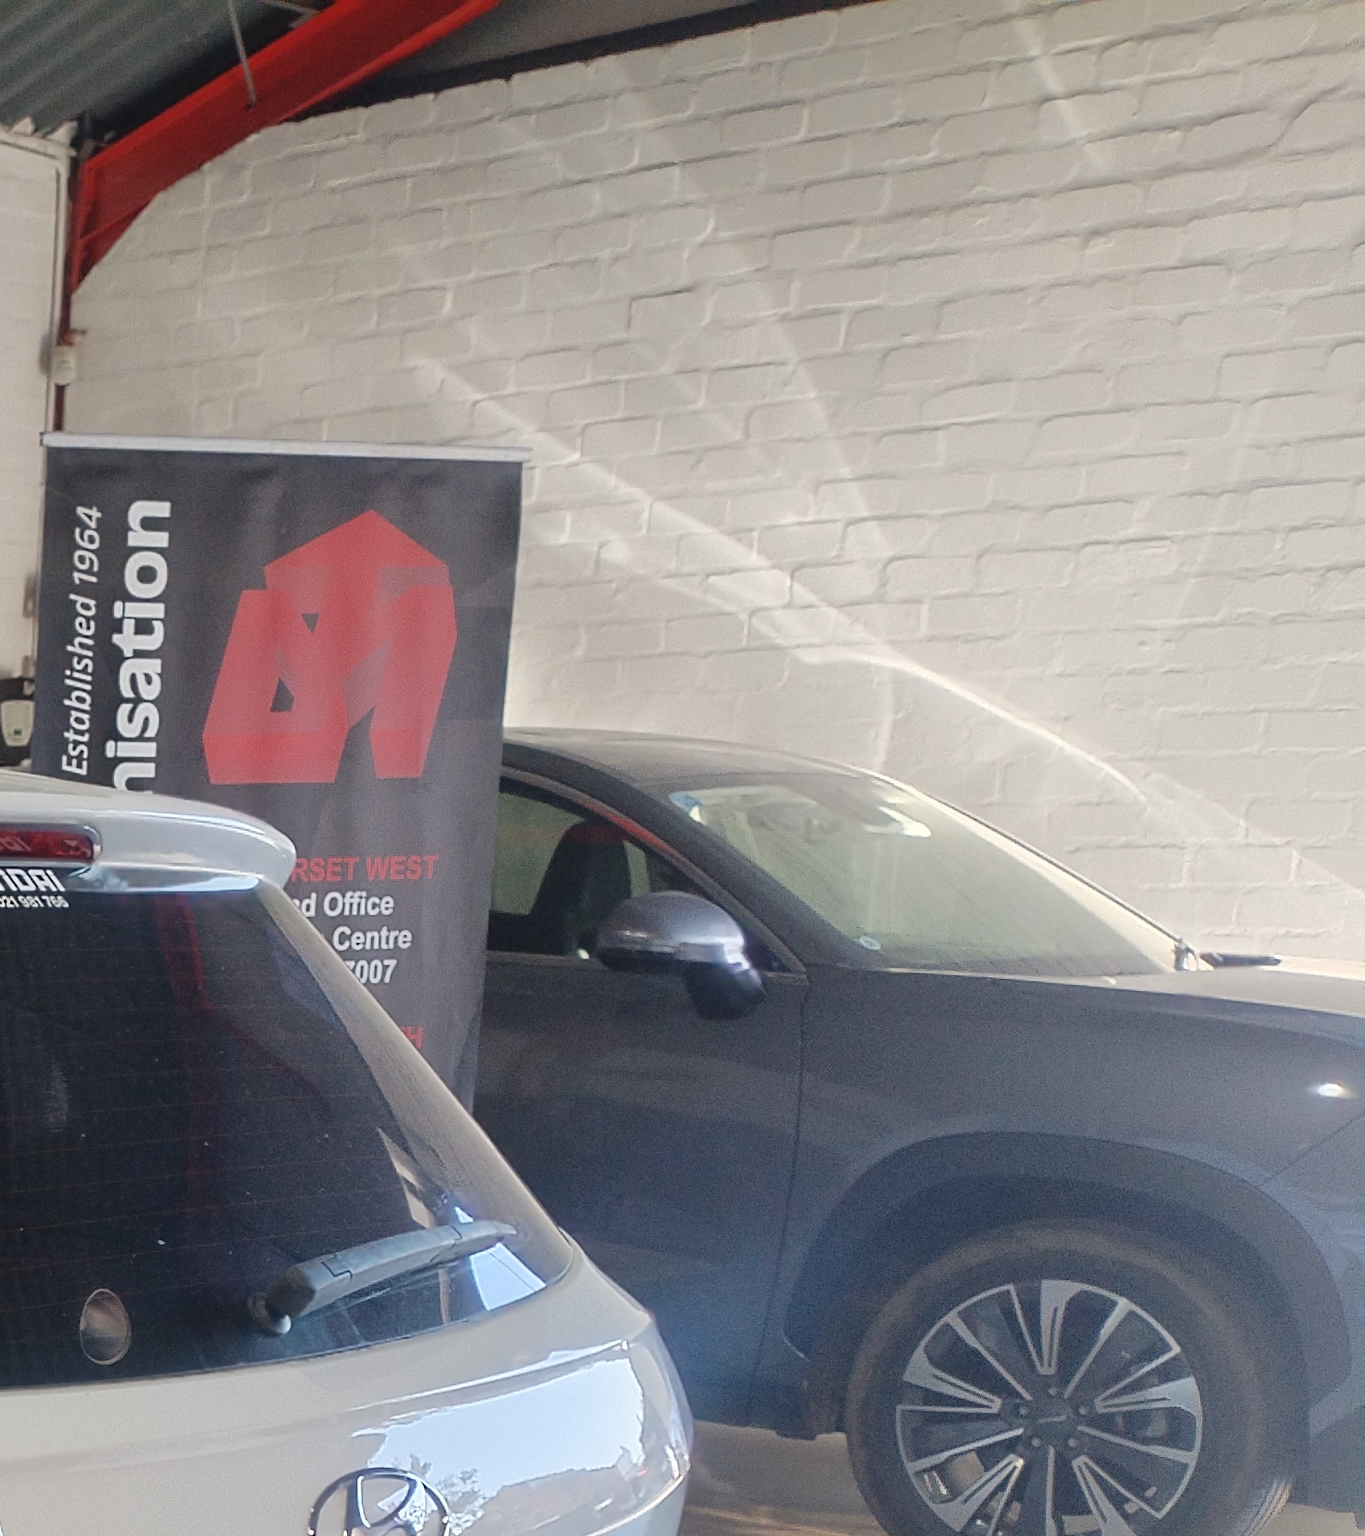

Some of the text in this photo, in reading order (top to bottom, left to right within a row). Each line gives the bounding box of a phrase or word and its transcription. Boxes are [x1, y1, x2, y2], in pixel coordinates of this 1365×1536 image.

[62, 505, 103, 776] Established 1964
[366, 853, 440, 882] WEST
[323, 890, 395, 917] Office
[332, 925, 413, 952] Centre
